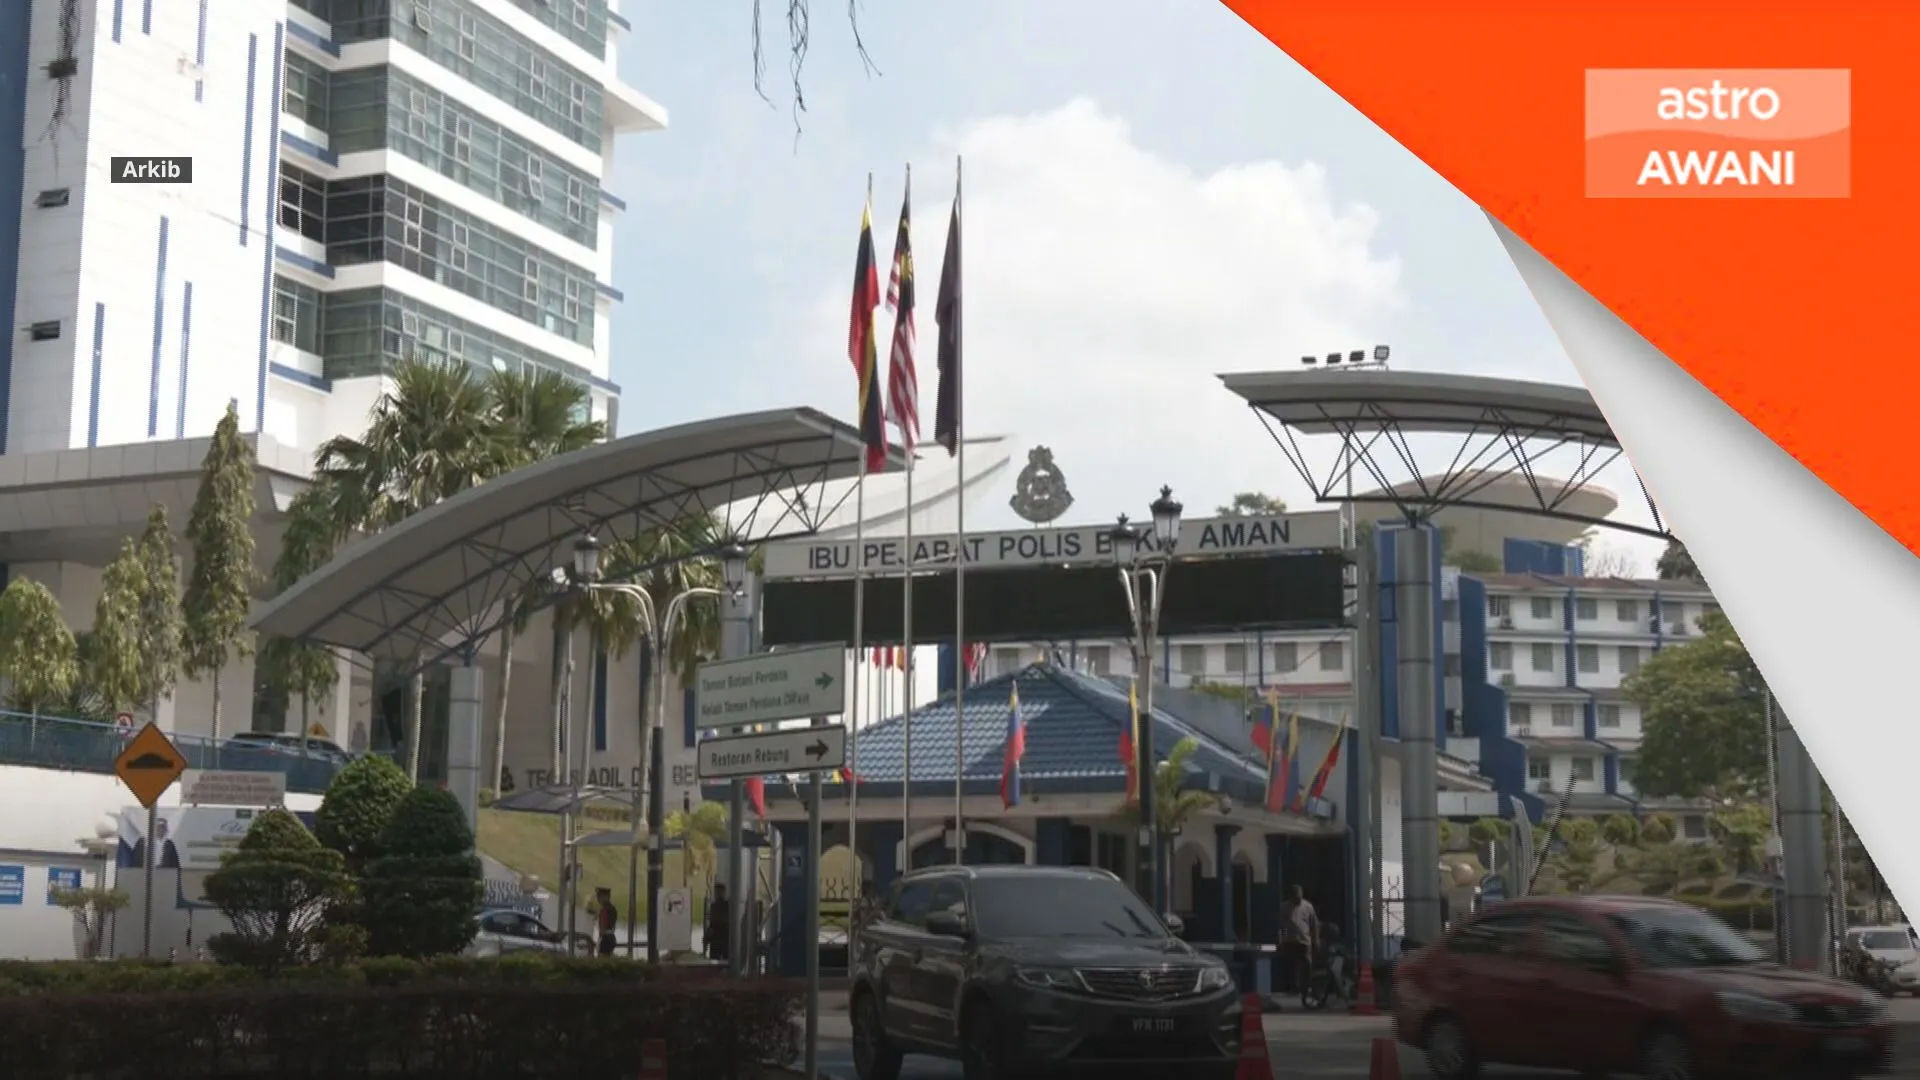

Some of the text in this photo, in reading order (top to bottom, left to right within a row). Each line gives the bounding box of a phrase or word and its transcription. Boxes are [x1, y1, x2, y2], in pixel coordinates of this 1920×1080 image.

[808, 544, 849, 569] IBU
[999, 532, 1081, 560] POLIS
[1198, 520, 1290, 549] AMAN
[711, 747, 789, 767] Restoran Rebung
[588, 766, 625, 787] ADIL
